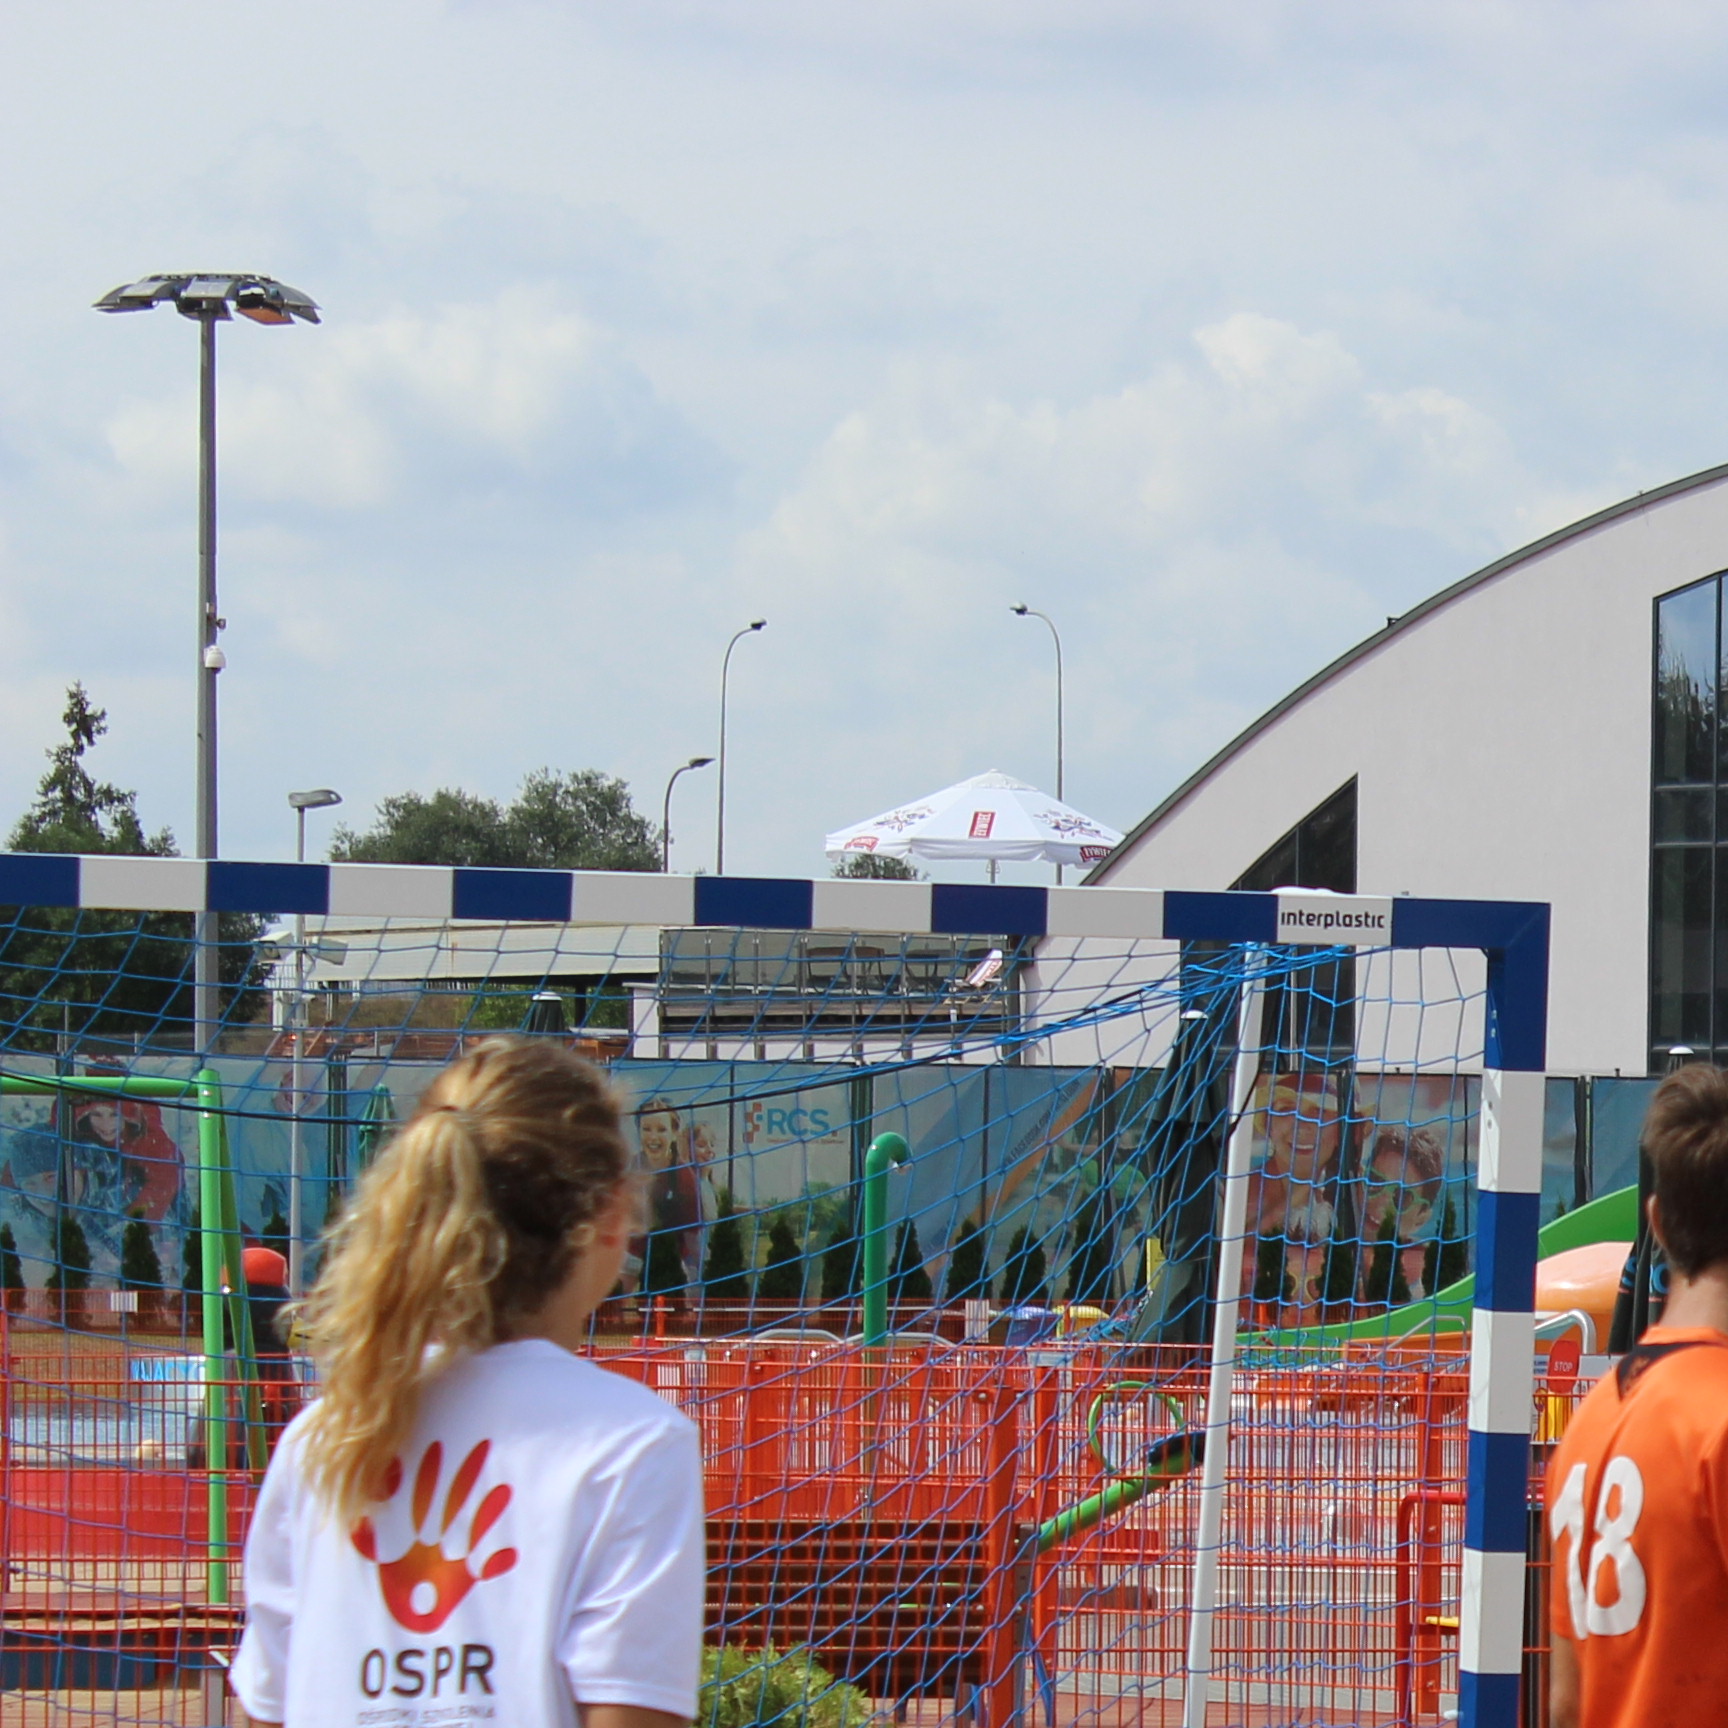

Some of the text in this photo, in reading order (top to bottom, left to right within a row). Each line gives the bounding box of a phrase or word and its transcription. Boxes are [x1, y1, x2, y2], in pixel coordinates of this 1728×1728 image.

[1281, 909, 1385, 930] interplastic
[767, 1108, 831, 1137] RCS
[1554, 1361, 1573, 1372] STOP
[1550, 1456, 1647, 1640] 18
[360, 1643, 496, 1700] OSPR
